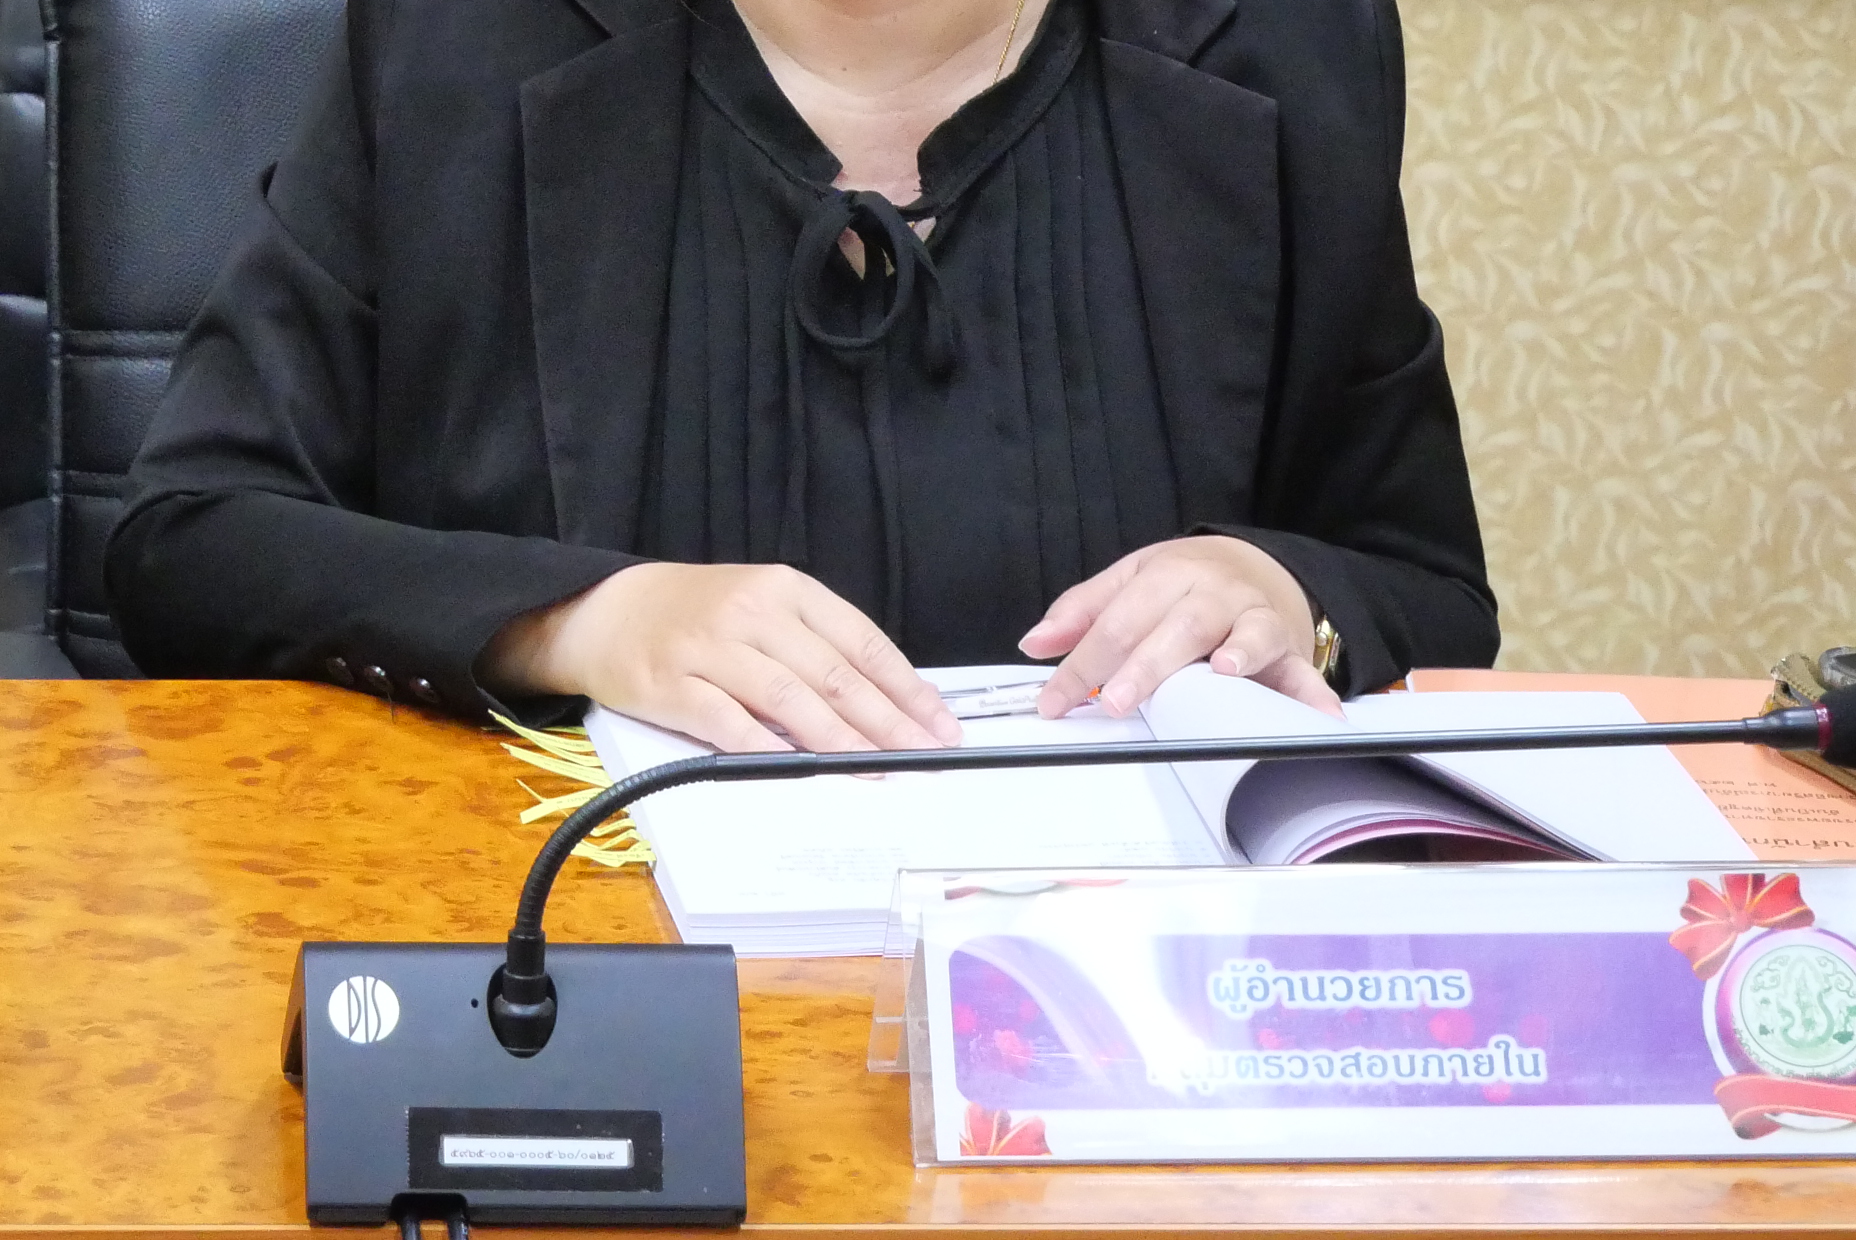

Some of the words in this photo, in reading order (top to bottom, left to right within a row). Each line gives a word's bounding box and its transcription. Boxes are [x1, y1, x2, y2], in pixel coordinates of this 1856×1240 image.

[1213, 963, 1466, 1013] ผู้อำนวยการ
